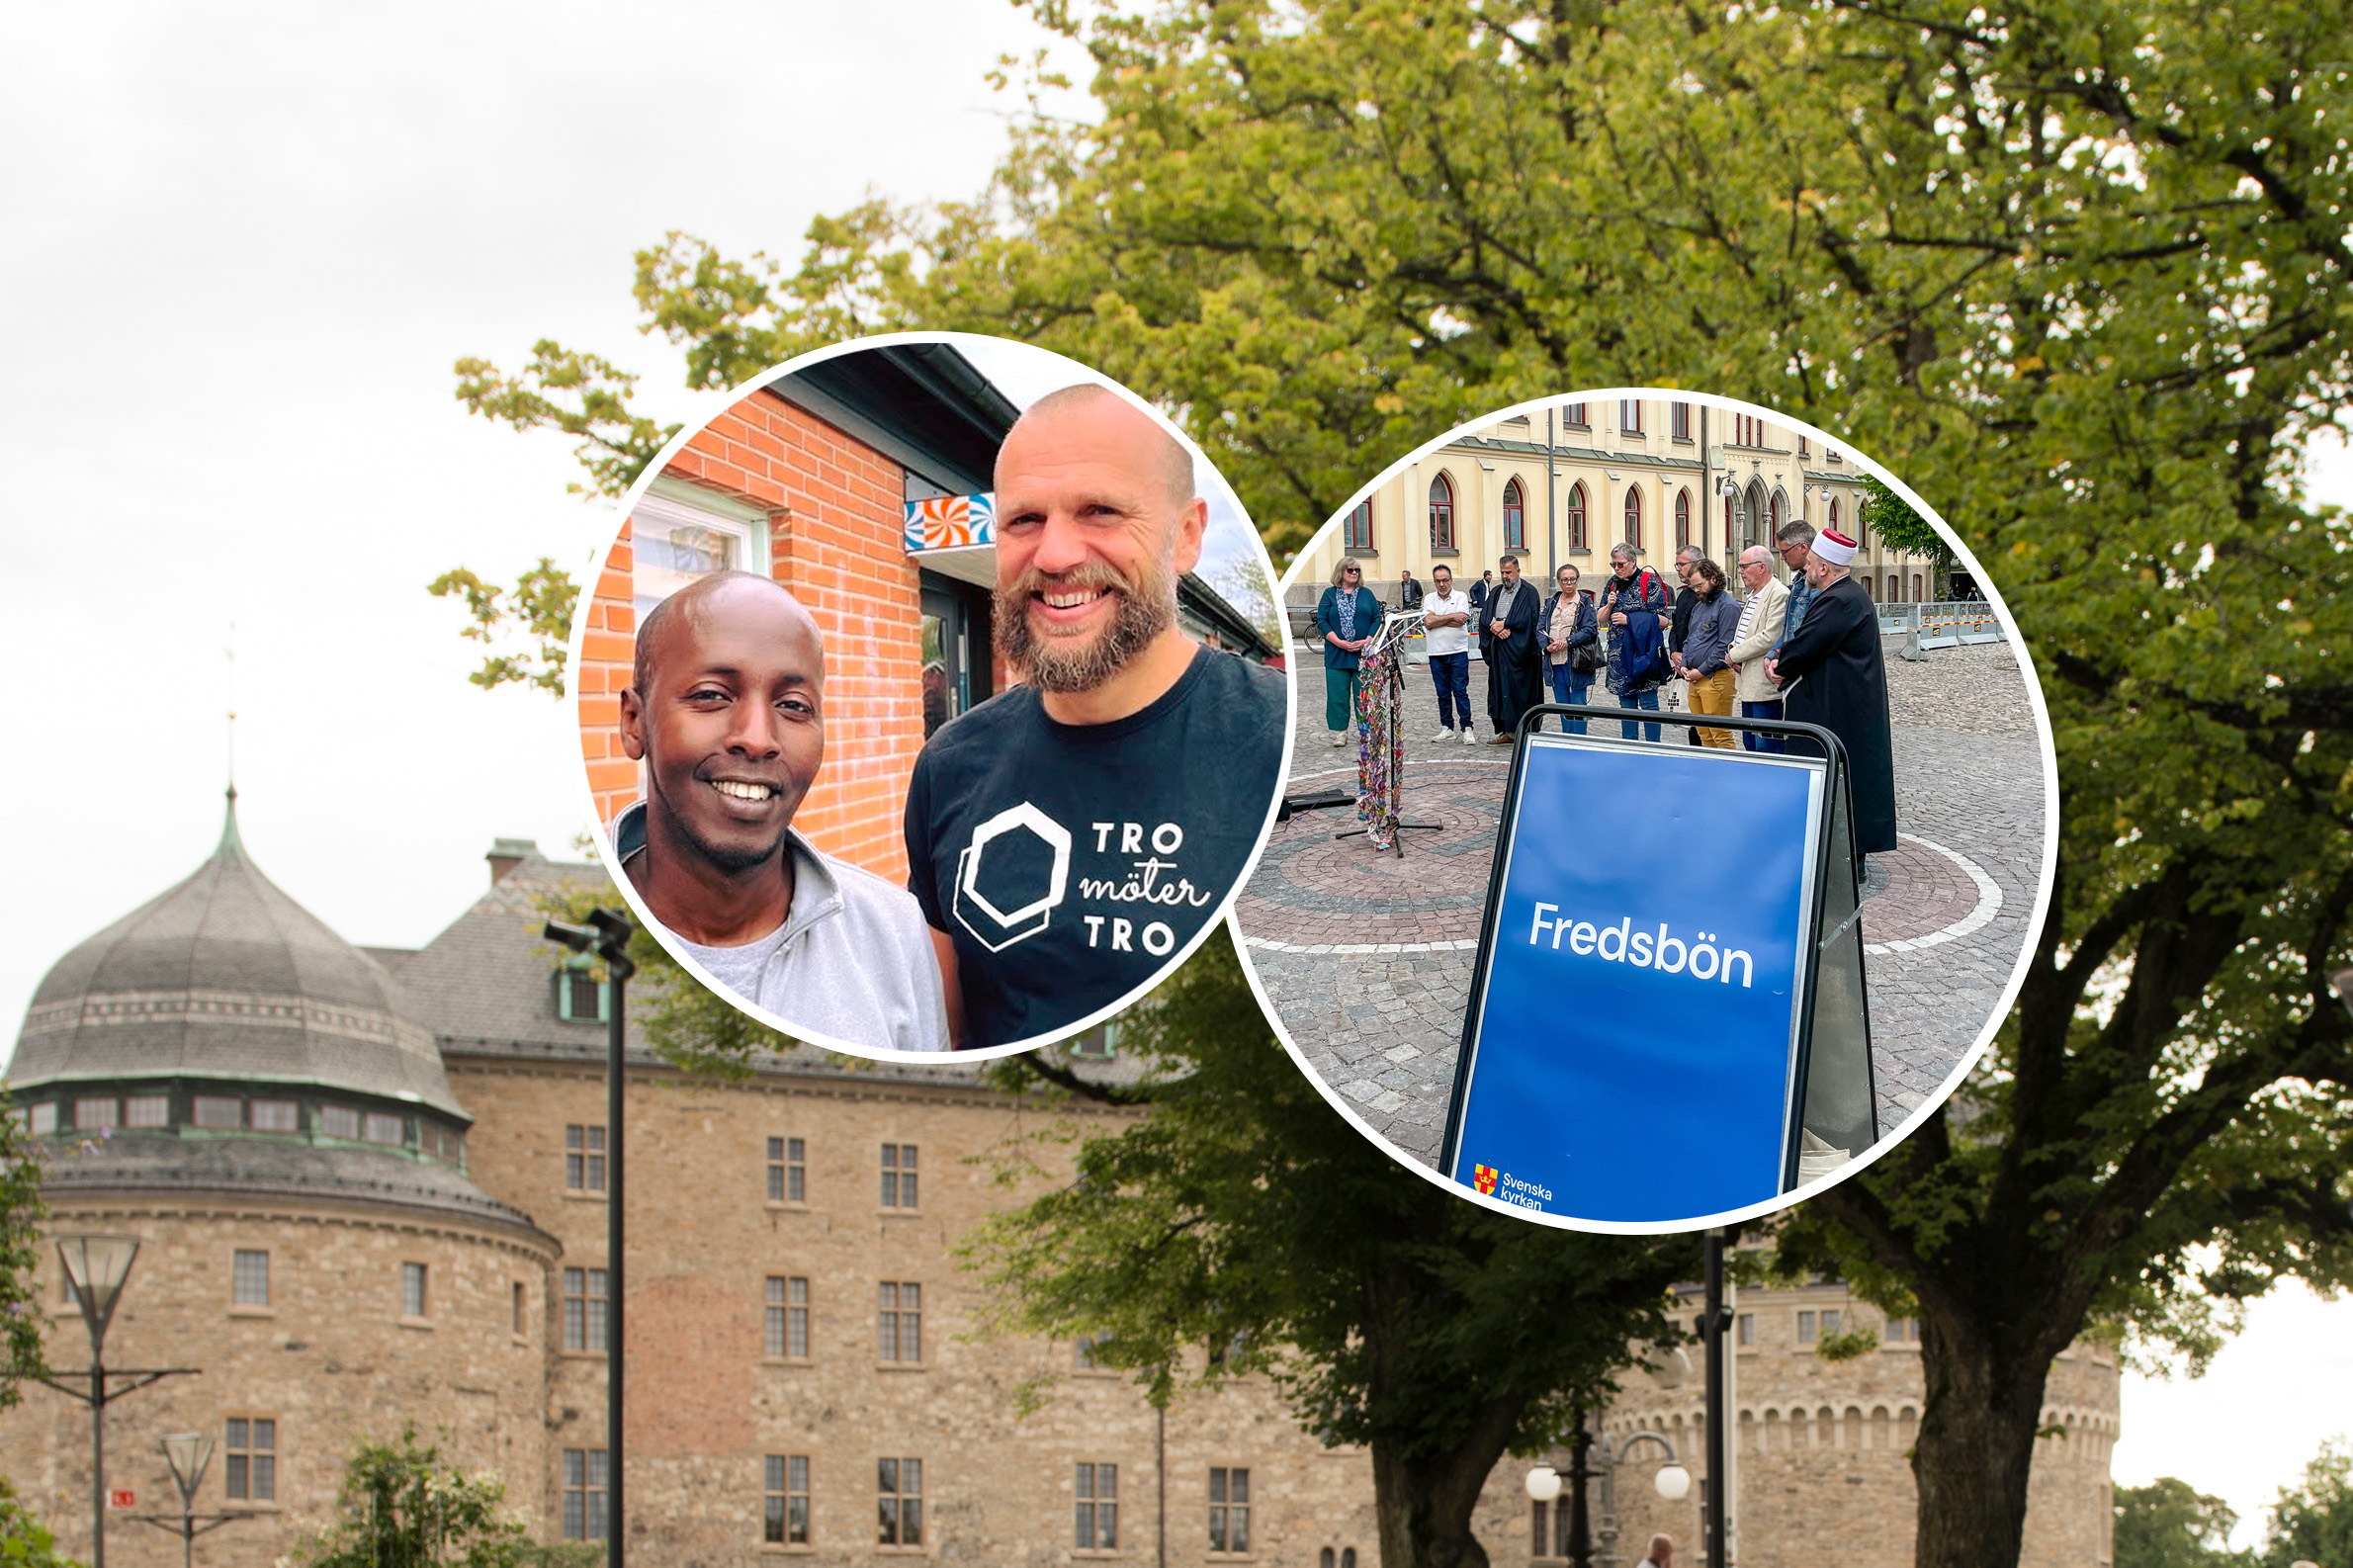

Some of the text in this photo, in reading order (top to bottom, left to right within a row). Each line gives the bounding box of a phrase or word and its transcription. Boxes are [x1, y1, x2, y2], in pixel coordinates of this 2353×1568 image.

[1091, 822, 1183, 855] TRO
[1079, 856, 1211, 908] möter
[1083, 915, 1176, 956] TRO
[1529, 902, 1753, 989] Fredsbön
[1500, 1185, 1542, 1212] kyrkan
[1503, 1173, 1552, 1201] Svenska
